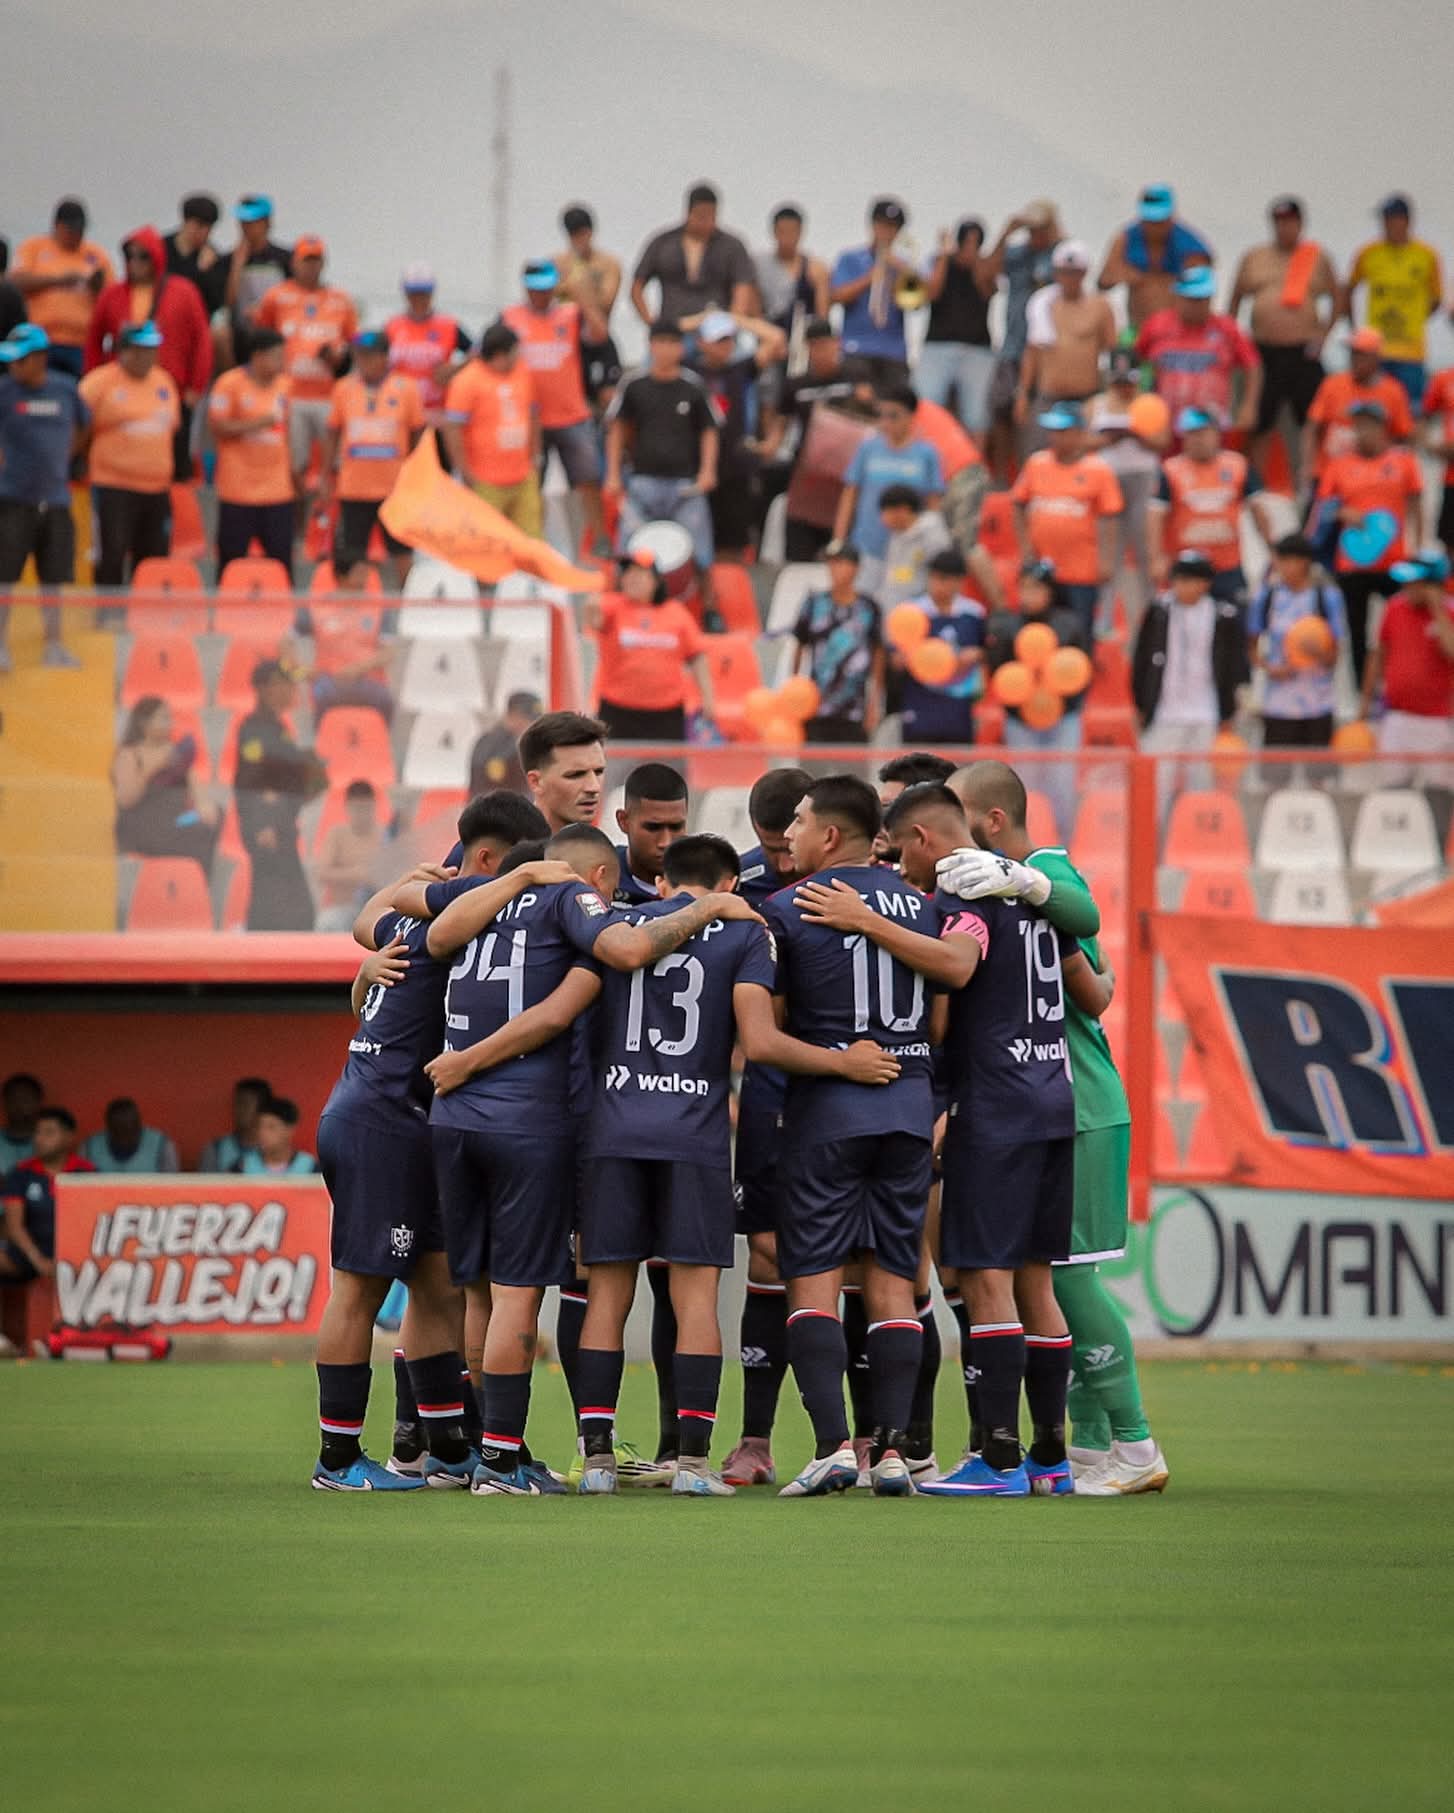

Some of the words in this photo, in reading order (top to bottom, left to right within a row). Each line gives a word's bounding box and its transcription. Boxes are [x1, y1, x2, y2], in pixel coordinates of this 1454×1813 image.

[444, 930, 527, 1030] 24
[626, 953, 705, 1056] 13
[843, 934, 925, 1033] 10
[1018, 919, 1065, 1023] 19
[638, 1073, 709, 1096] walon
[56, 1254, 316, 1327] VALLEJO!
